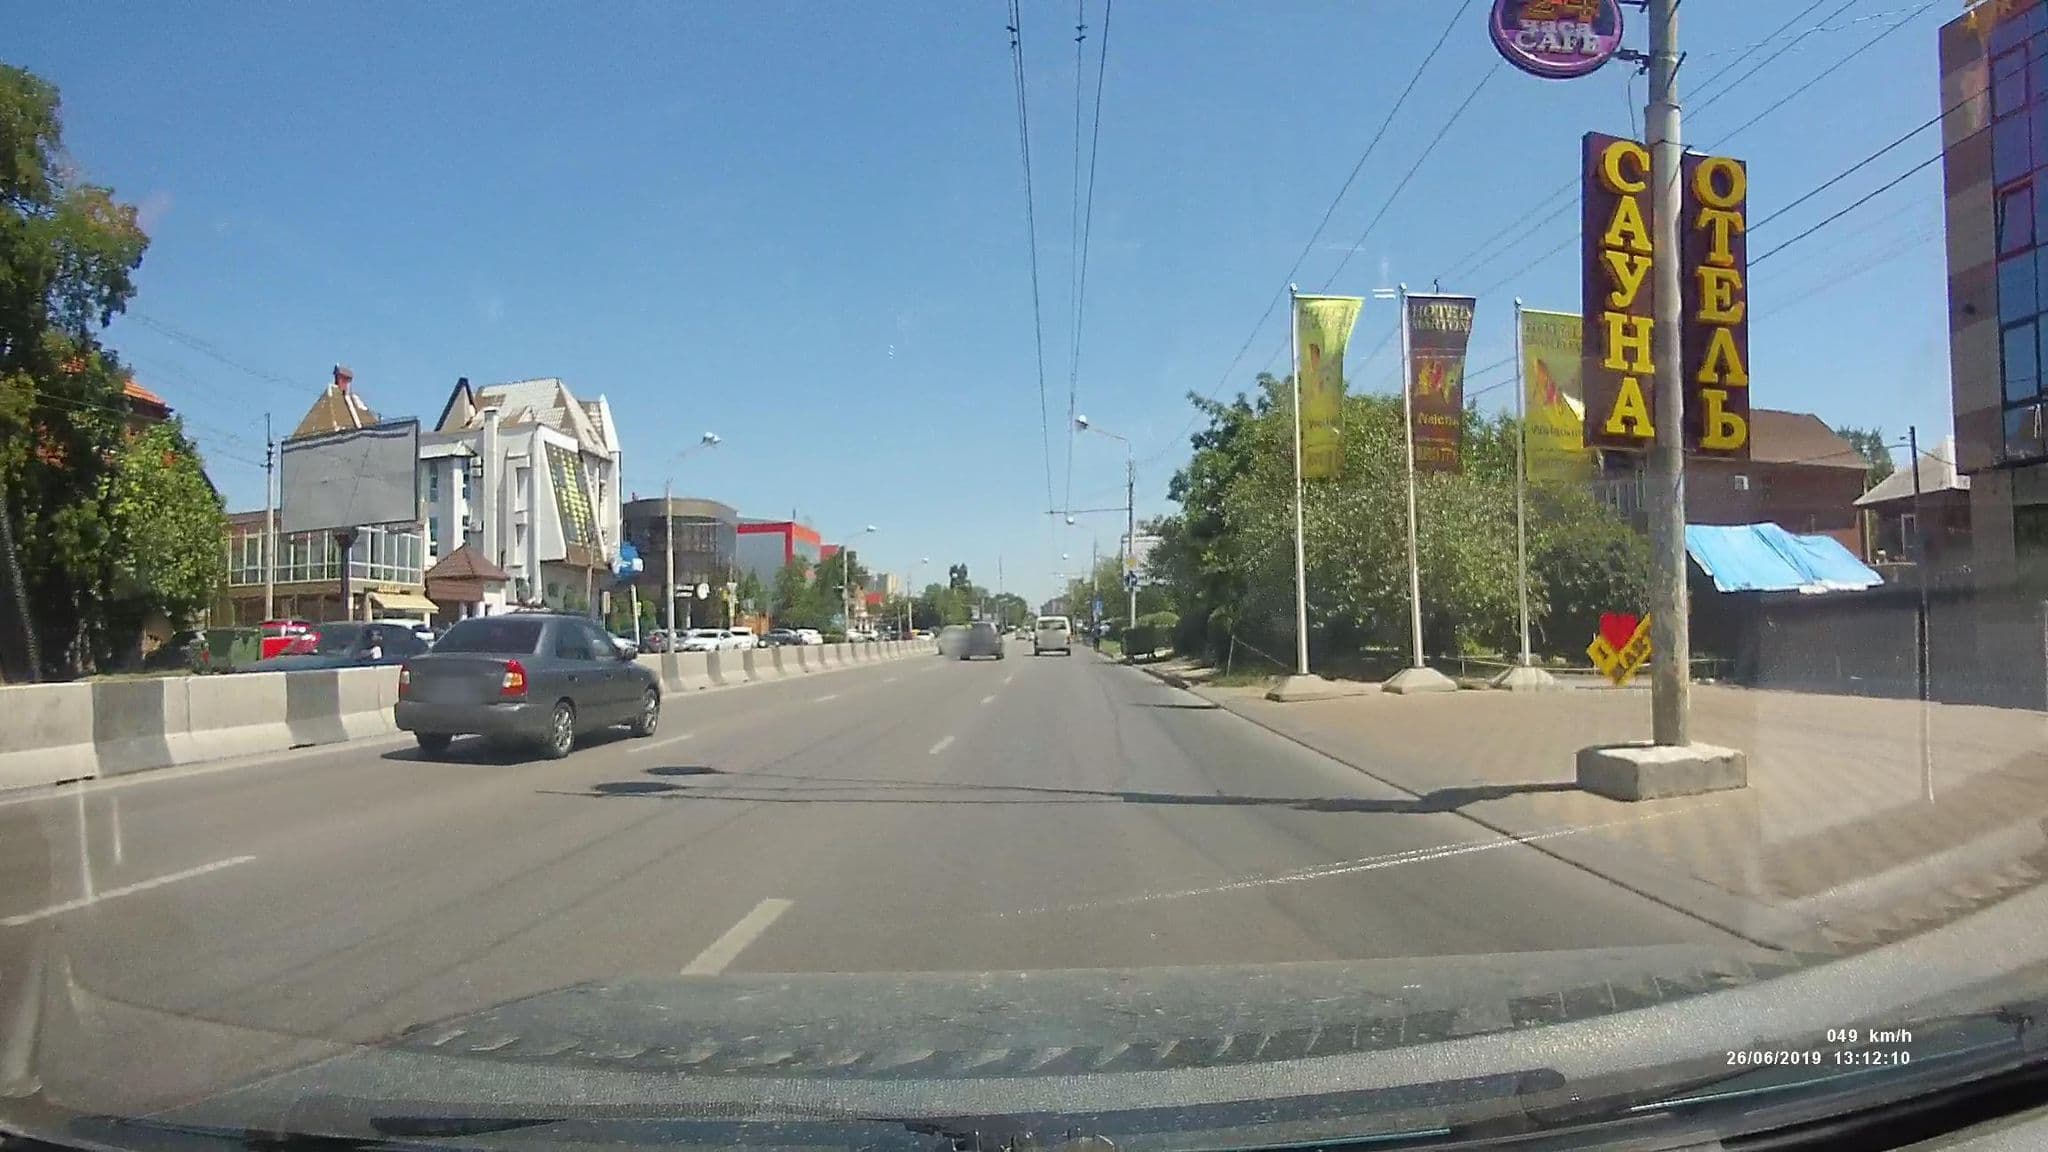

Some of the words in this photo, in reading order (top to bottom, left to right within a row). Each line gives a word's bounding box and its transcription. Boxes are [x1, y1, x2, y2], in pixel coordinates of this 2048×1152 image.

[1514, 30, 1599, 55] CAFE
[1601, 141, 1655, 437] САУНА
[1693, 156, 1747, 449] ОТЕЛЬ
